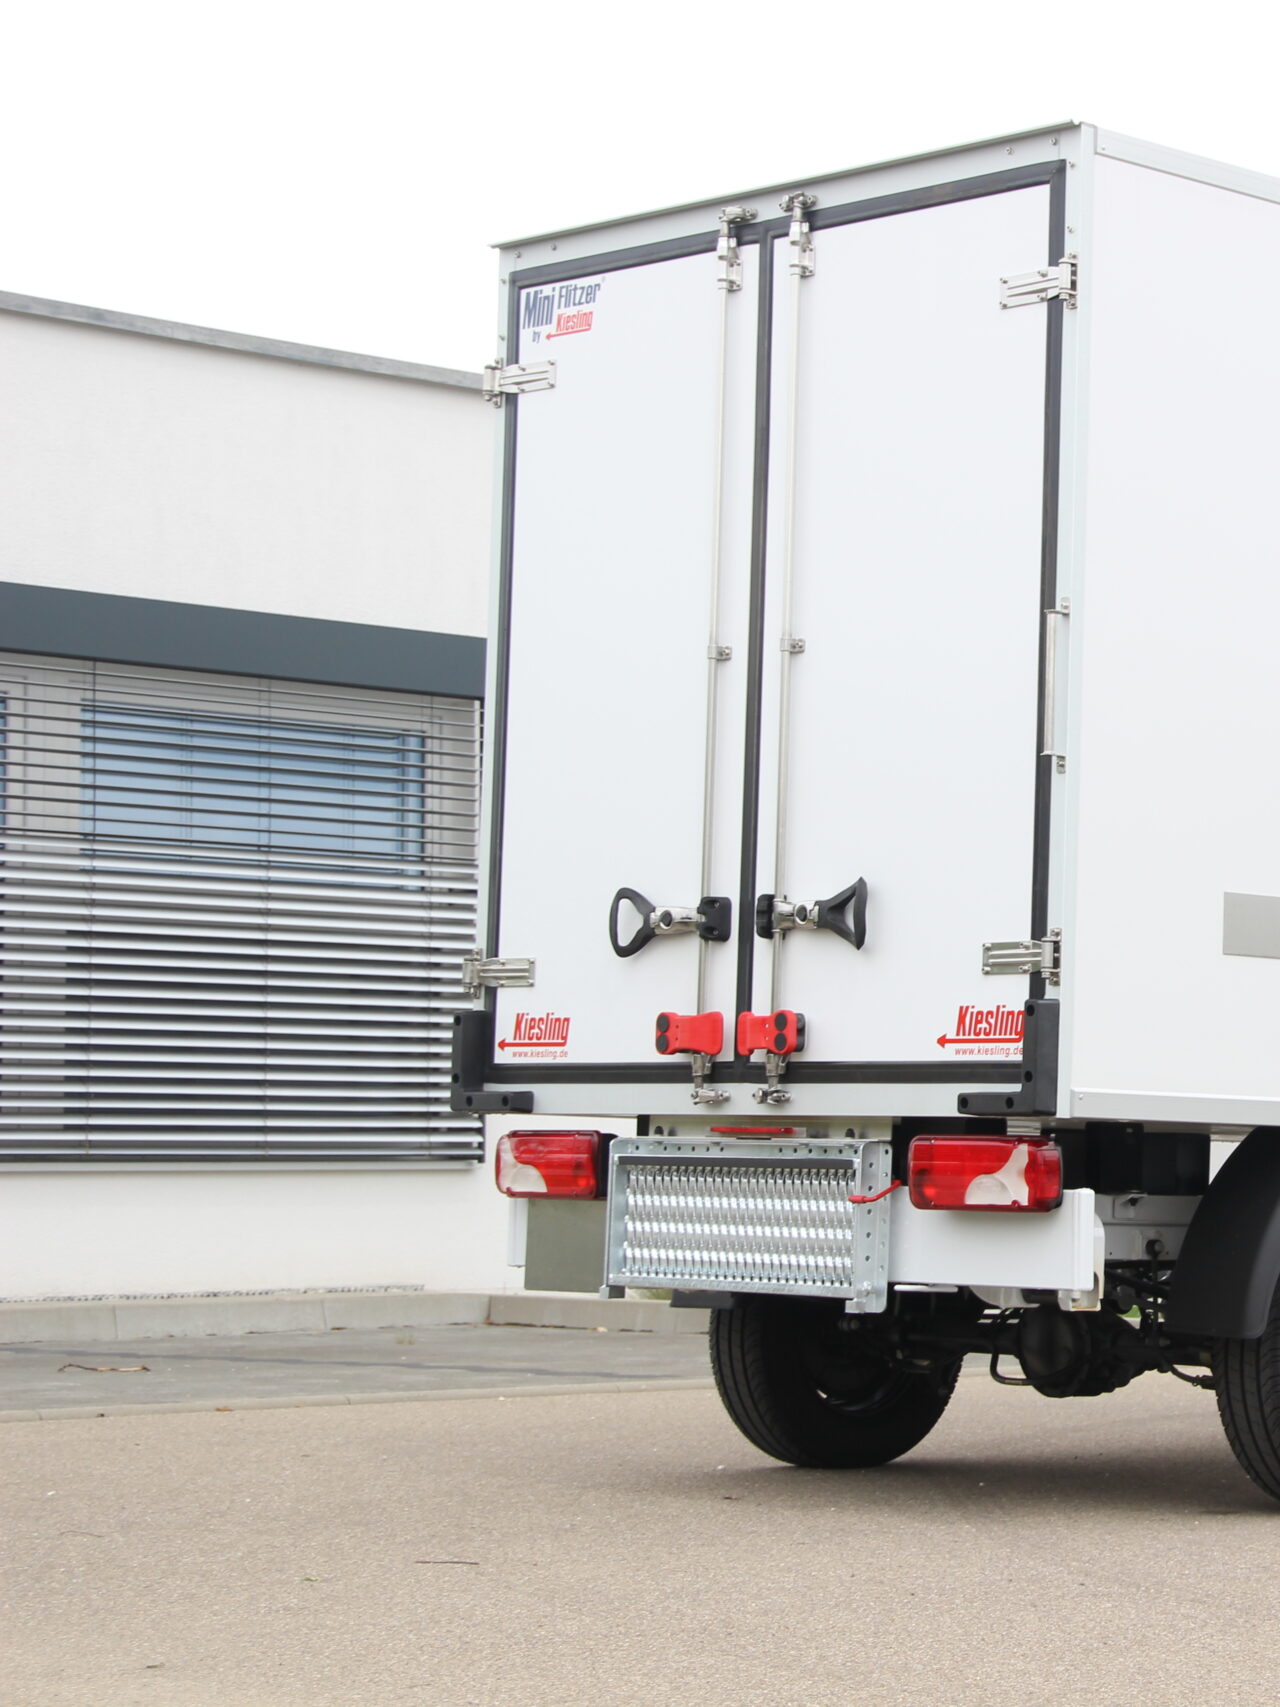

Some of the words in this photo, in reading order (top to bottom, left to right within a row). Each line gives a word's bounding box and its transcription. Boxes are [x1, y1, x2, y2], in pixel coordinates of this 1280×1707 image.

[522, 287, 555, 329] Mini
[557, 282, 601, 309] Flitzer
[532, 330, 541, 343] by
[556, 310, 593, 332] Kiesling
[513, 1012, 571, 1042] Kiesling
[956, 1005, 1025, 1037] Kiesling
[512, 1049, 568, 1059] www.kiesling.de
[955, 1046, 1024, 1057] www.kiesling.de
